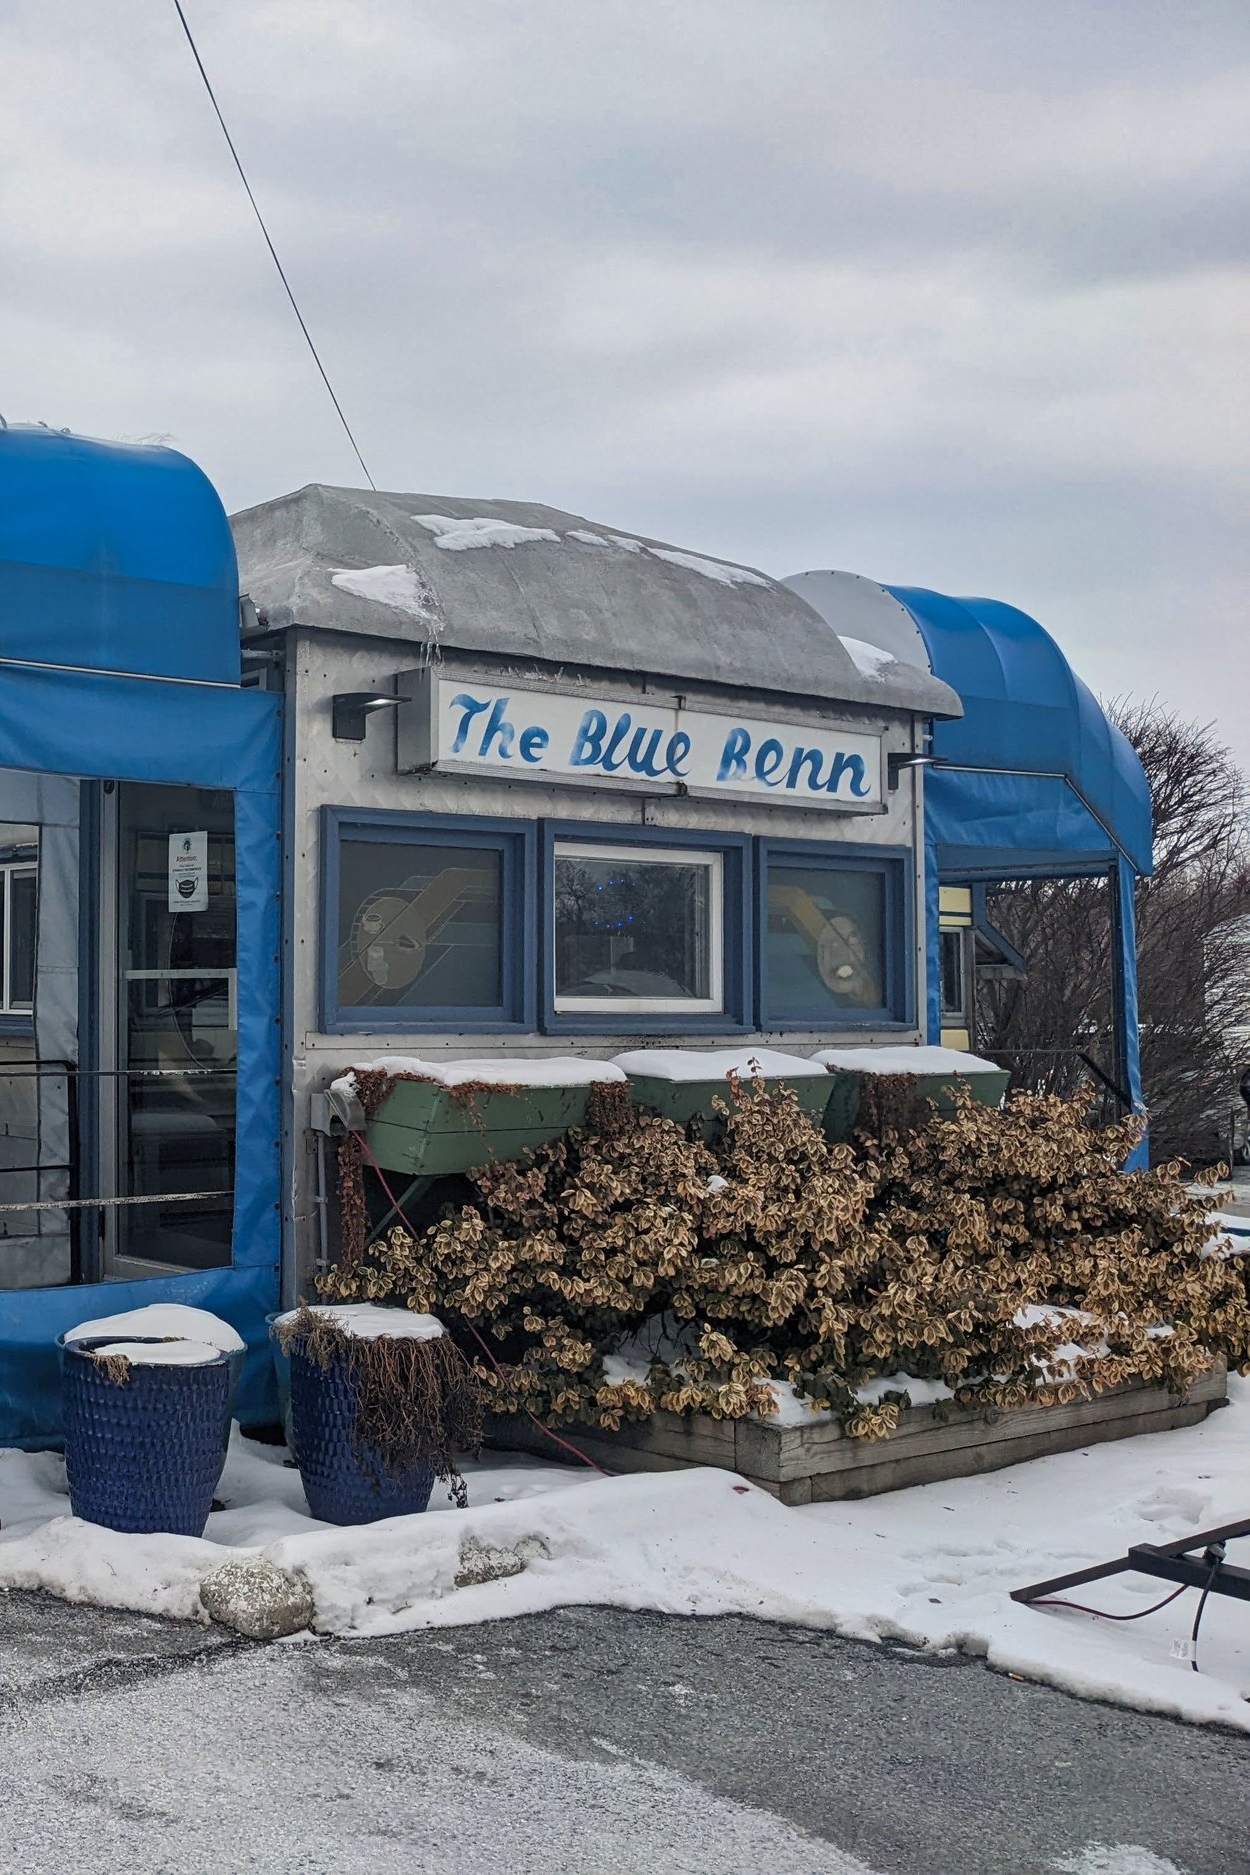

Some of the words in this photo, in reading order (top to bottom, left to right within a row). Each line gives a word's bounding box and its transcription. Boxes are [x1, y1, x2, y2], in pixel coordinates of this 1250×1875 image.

[448, 693, 550, 763] The
[569, 709, 692, 778] Blue
[716, 727, 872, 798] Benn
